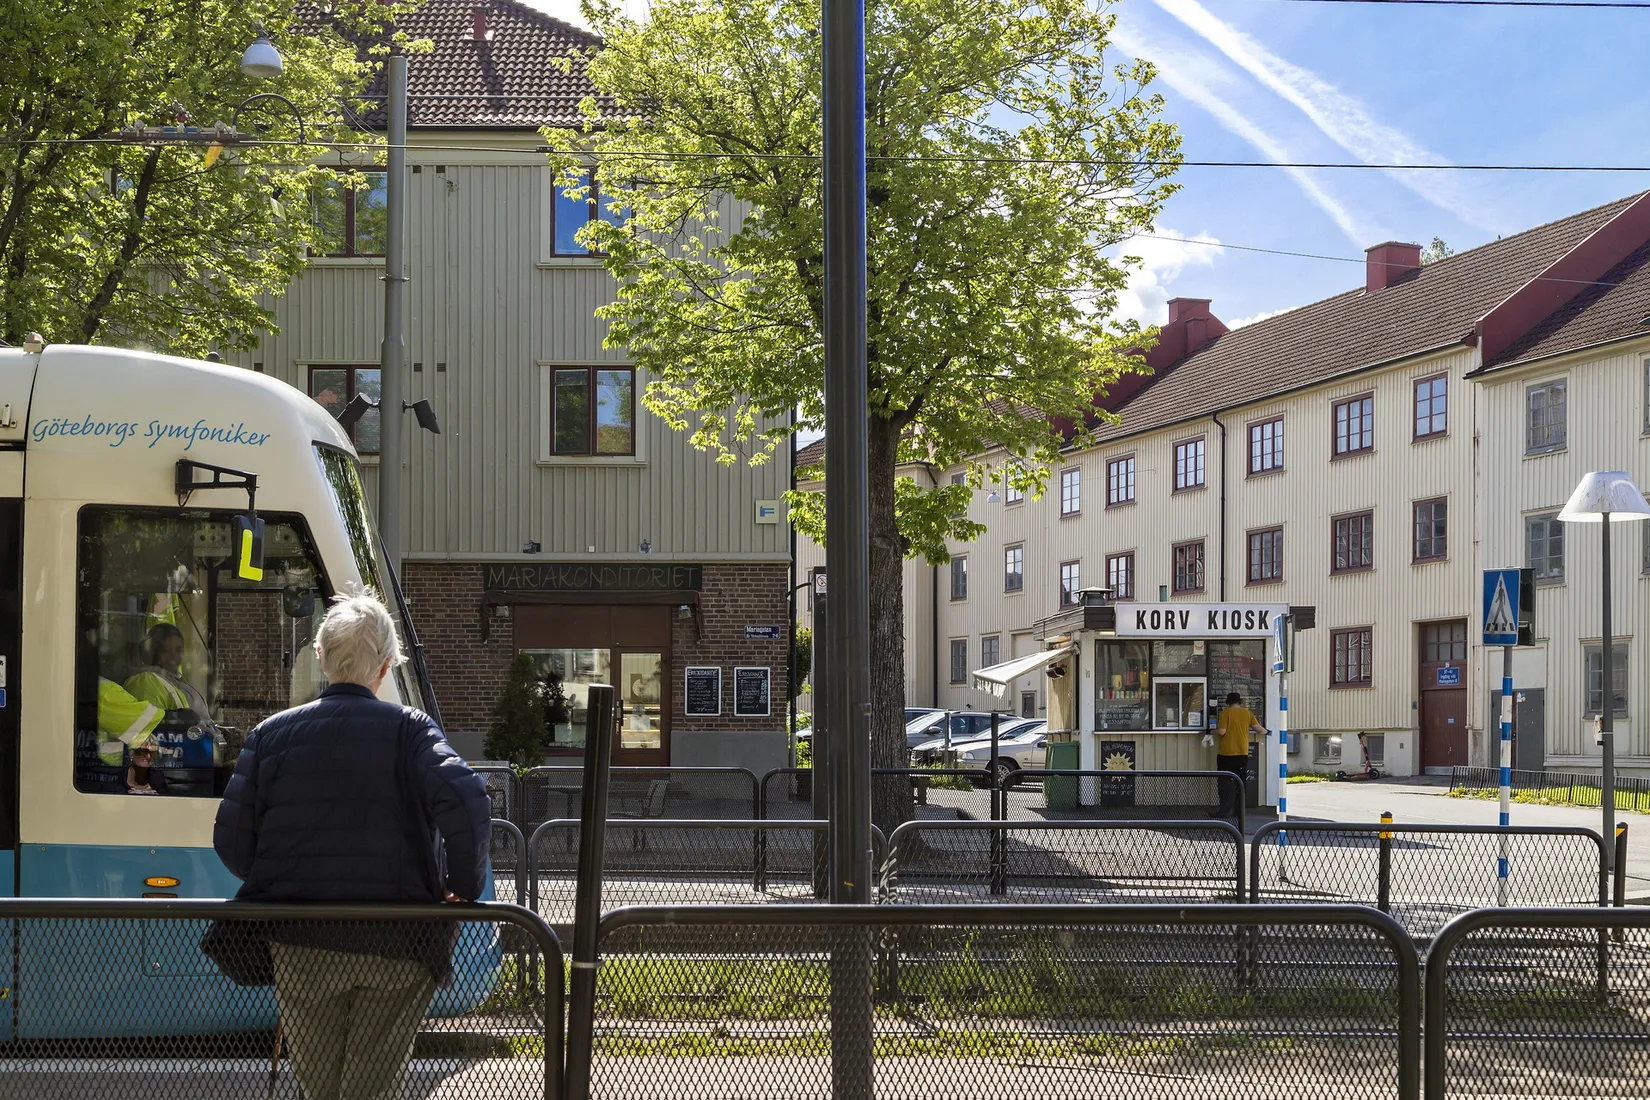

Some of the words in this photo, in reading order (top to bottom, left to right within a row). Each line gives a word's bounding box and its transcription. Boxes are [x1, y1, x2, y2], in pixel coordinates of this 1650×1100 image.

[32, 414, 139, 447] Göteborgs
[143, 419, 271, 450] Symfoniker
[488, 566, 699, 589] MARIAKONDITORIET
[1136, 609, 1190, 631] KORV
[1207, 609, 1270, 631] KIOSK
